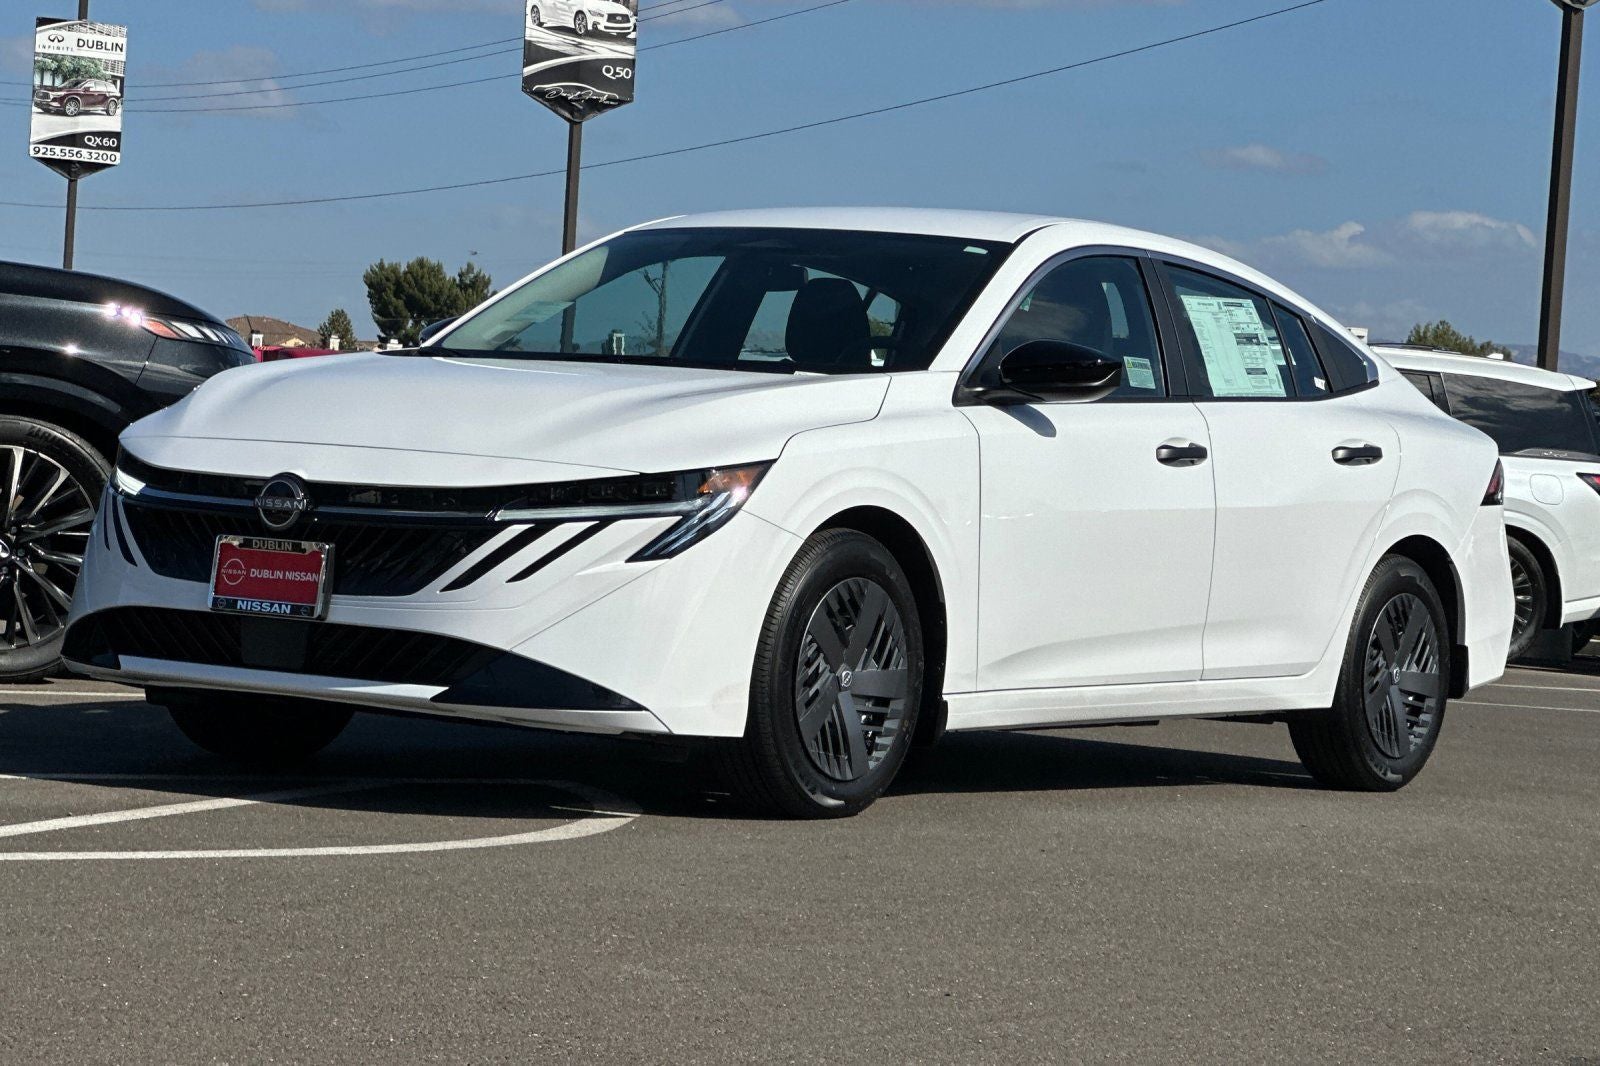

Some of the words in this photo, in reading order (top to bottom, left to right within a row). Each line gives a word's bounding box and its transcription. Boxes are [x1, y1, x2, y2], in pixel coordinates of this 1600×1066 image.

[38, 44, 74, 52] INFINITI
[77, 38, 124, 52] DUBLIN
[602, 65, 632, 80] Q50
[84, 135, 118, 147] QX60
[33, 146, 117, 163] 925.556.3200
[254, 497, 305, 510] NISSAN
[252, 539, 293, 551] DUBLIN
[221, 568, 247, 576] NISSAN
[250, 568, 283, 579] DUBLIN
[285, 570, 320, 583] NISSAN
[237, 600, 292, 614] NISSAN
